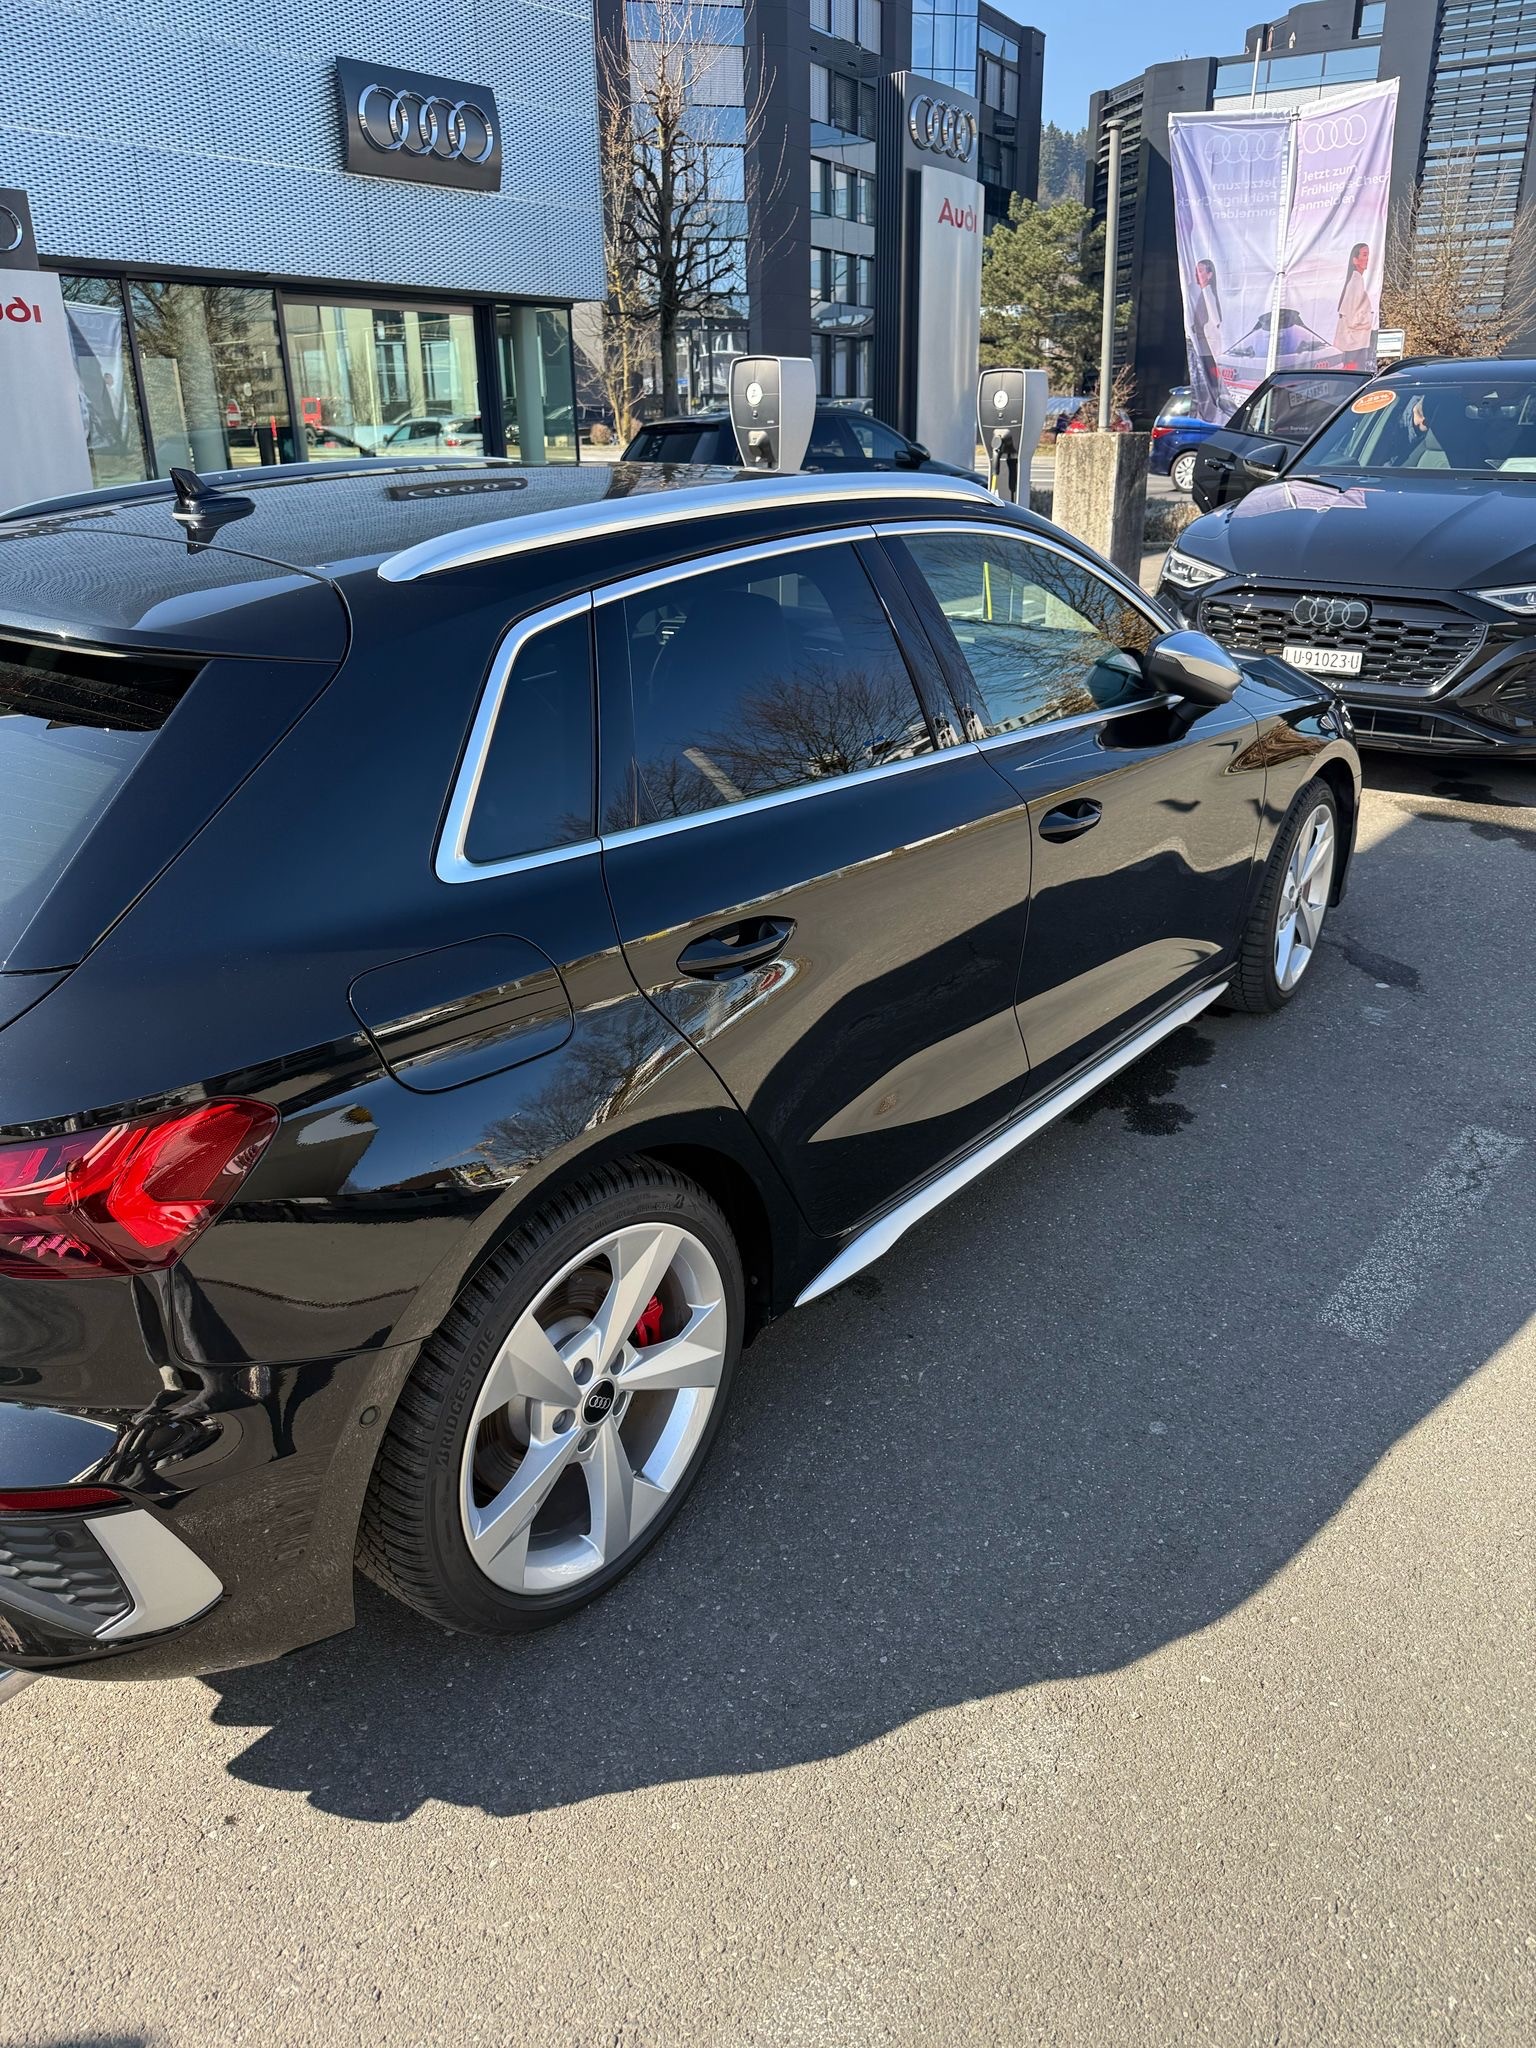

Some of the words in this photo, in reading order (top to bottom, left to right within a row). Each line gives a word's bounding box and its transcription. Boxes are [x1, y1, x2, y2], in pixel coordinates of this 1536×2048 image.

[1302, 167, 1331, 184] Jetzt
[1332, 164, 1358, 177] zum
[937, 197, 977, 234] Audi
[435, 1327, 495, 1467] BRIDGESTONE
